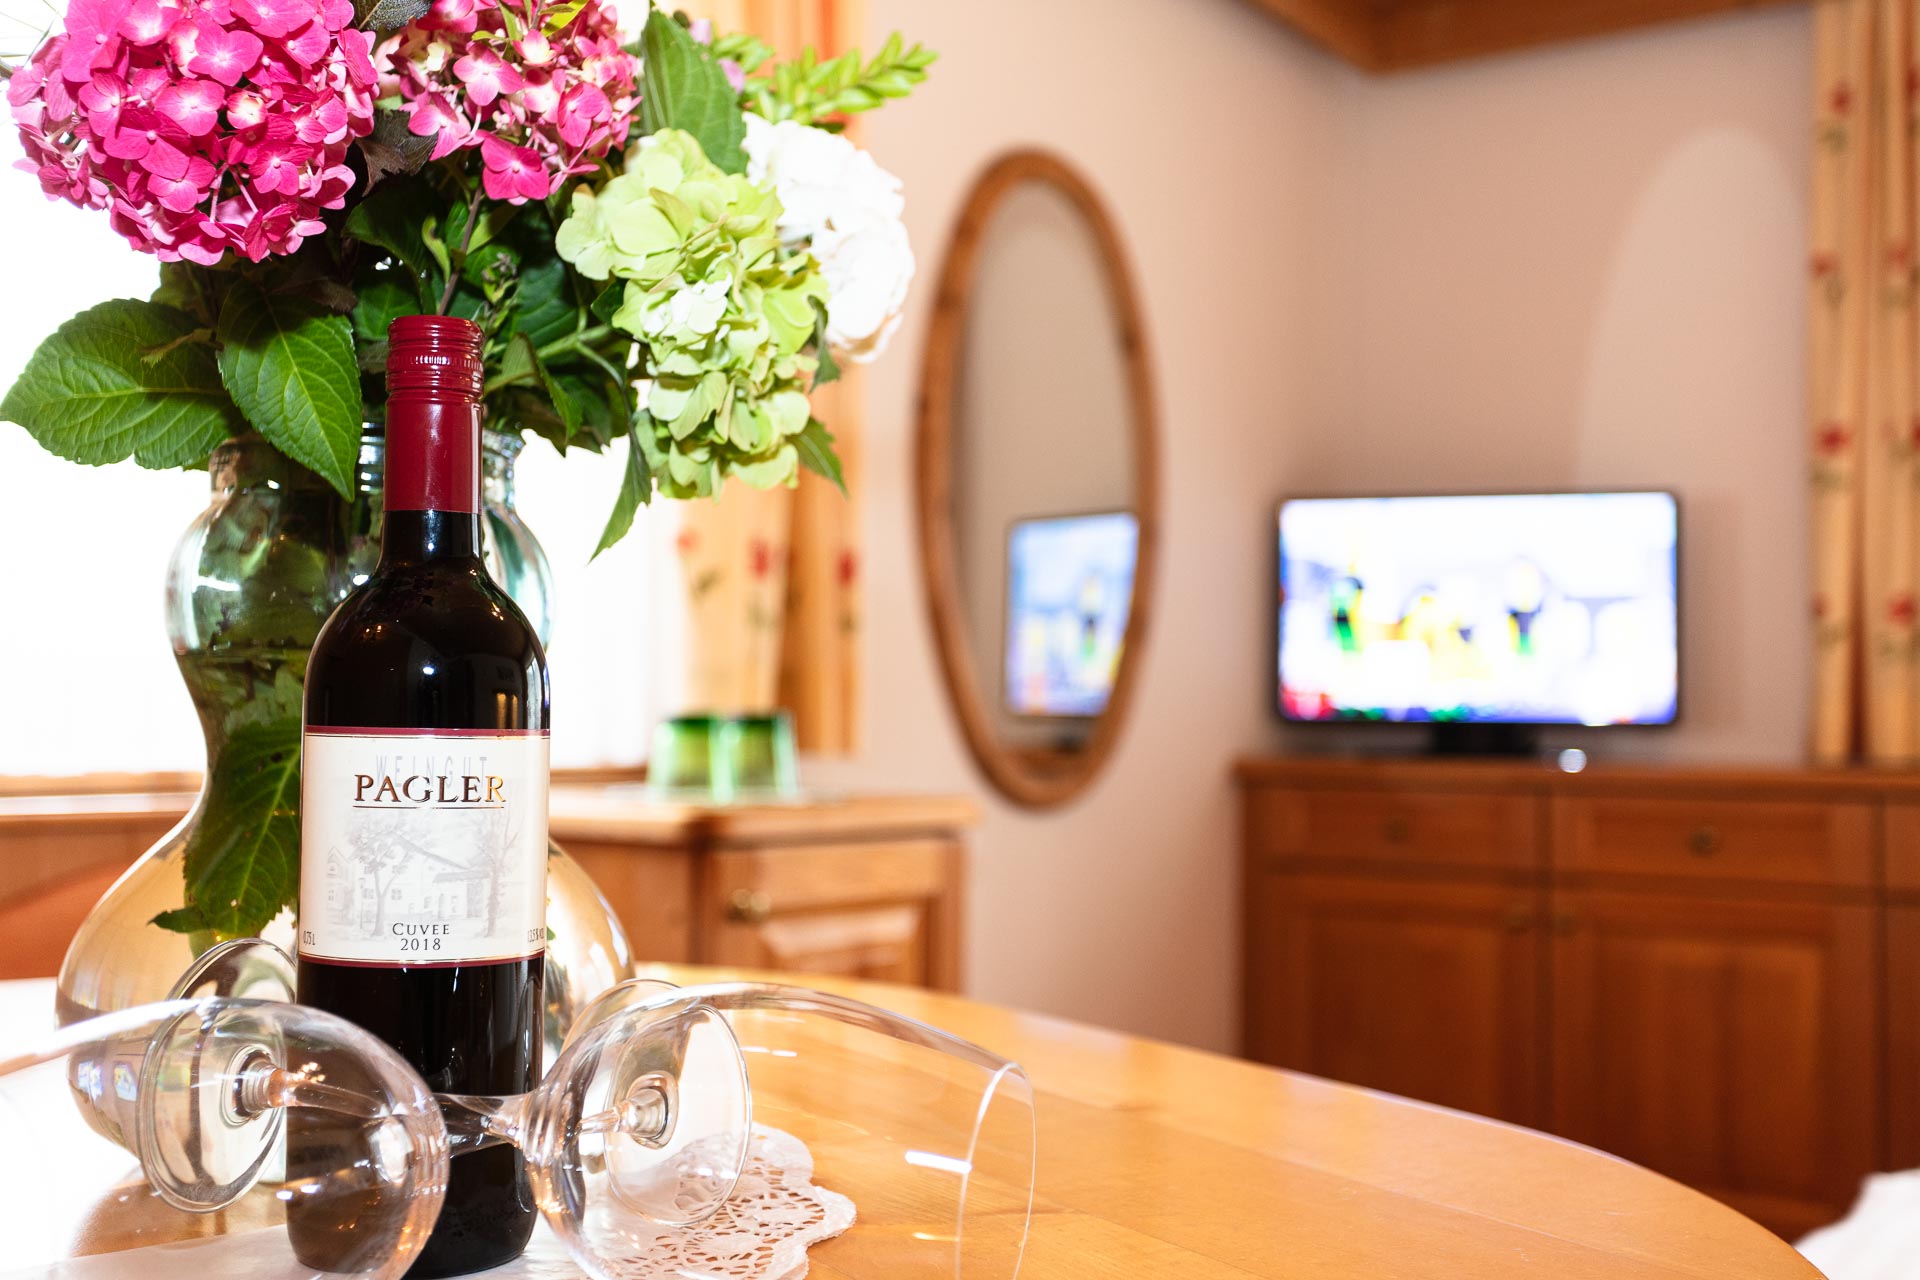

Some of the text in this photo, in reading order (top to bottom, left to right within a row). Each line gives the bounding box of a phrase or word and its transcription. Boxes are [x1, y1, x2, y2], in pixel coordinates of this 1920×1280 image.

[375, 755, 488, 788] WEINGUT
[353, 774, 507, 803] PAGLER
[400, 938, 441, 951] 2018
